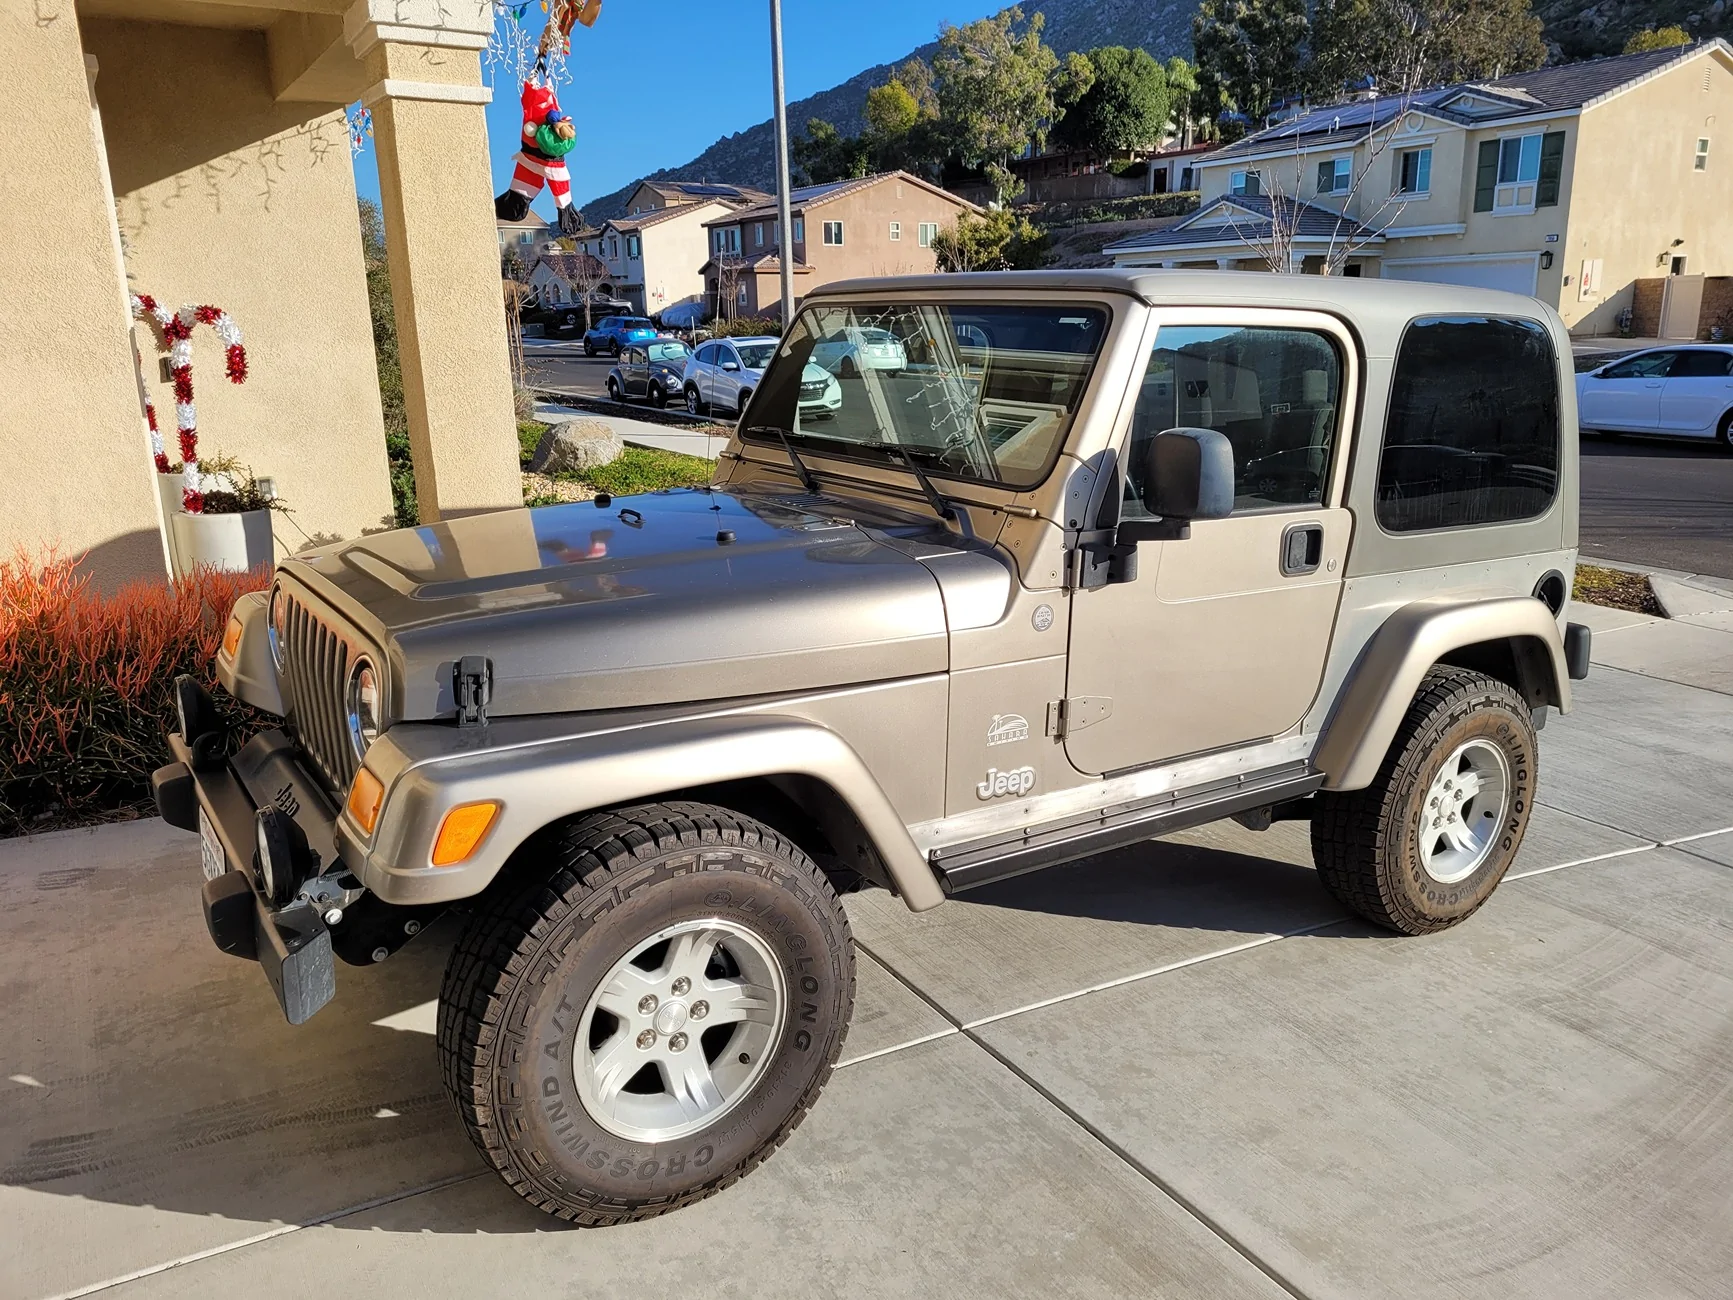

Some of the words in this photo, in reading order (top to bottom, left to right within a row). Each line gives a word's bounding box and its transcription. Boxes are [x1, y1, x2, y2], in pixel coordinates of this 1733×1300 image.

[988, 728, 1028, 742] SAHARA
[977, 766, 1036, 800] Jeep
[1502, 734, 1527, 852] LINGLONG
[1409, 810, 1458, 905] CROSSWIND
[738, 896, 821, 1052] LINGLONG
[544, 994, 573, 1060] A/T
[542, 1075, 714, 1180] CROSSWIND
